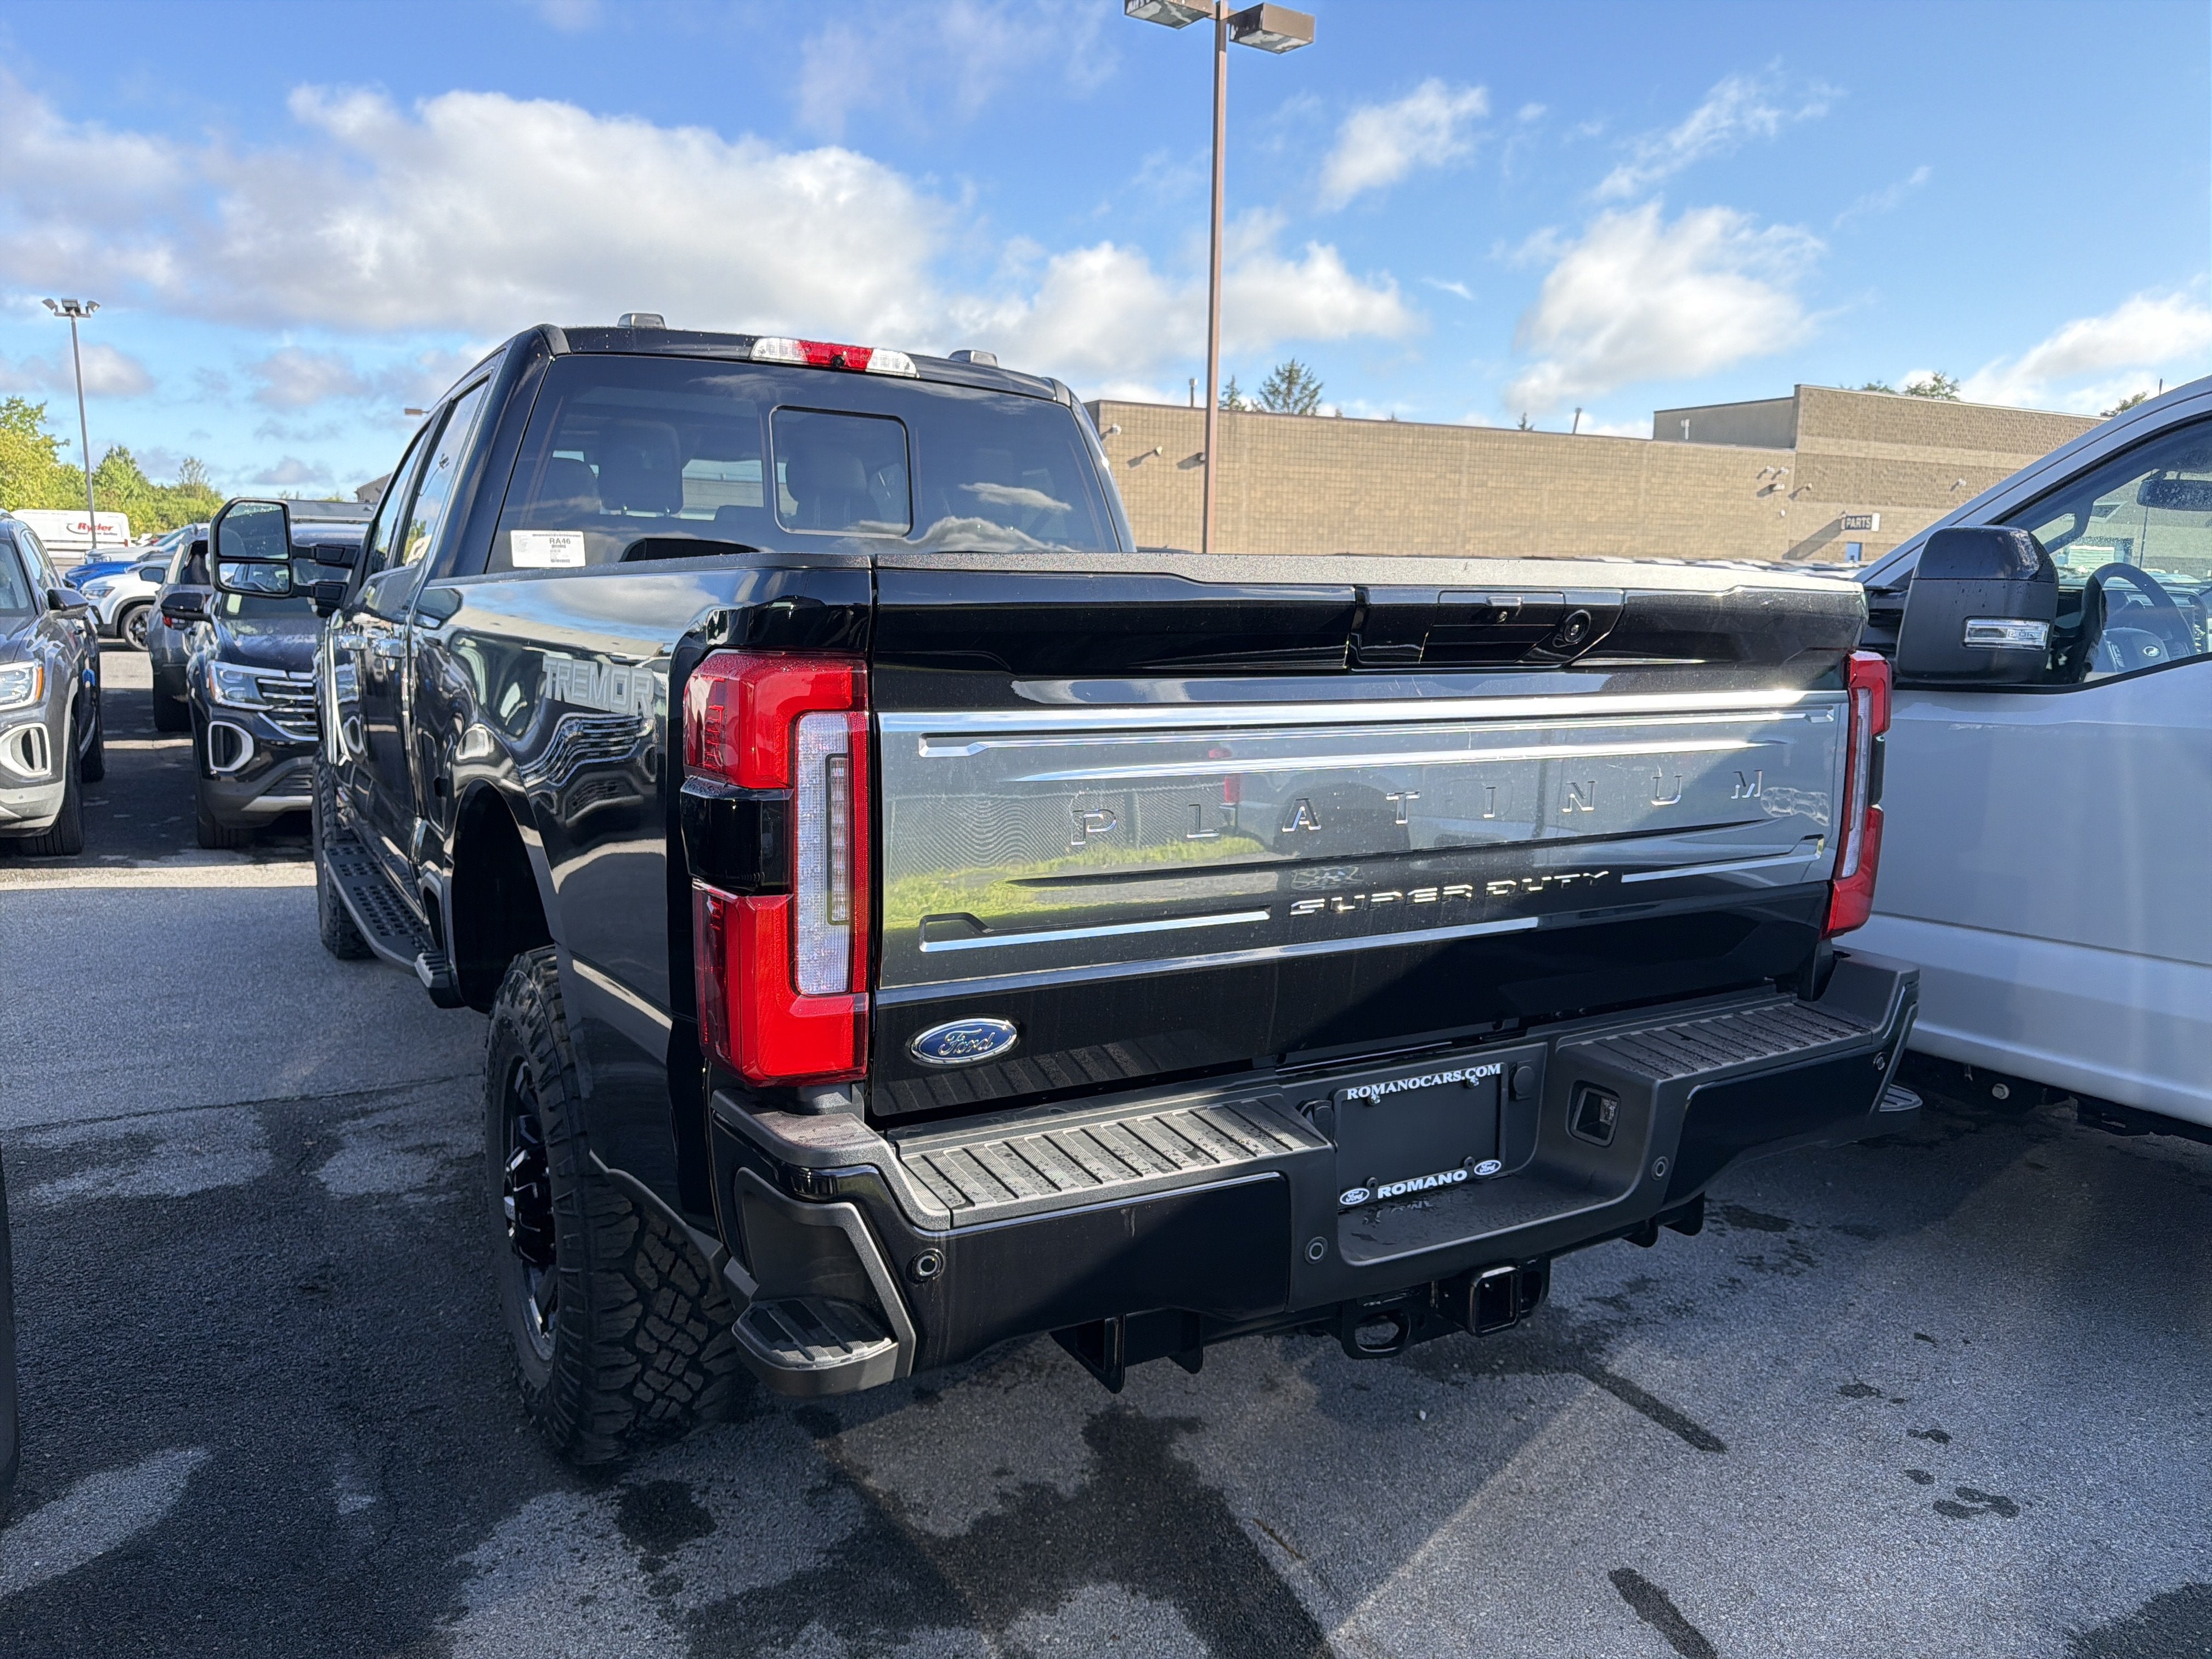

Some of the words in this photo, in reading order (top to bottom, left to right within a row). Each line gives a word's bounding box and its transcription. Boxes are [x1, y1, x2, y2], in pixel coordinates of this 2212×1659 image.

[1846, 517, 1871, 528] PARTS
[543, 656, 655, 719] TREMOR
[1071, 769, 1763, 846] PLATINUM
[1289, 884, 1473, 917] SUPER
[1485, 870, 1609, 897] DUTY
[938, 1028, 996, 1056] Ford
[1347, 1063, 1501, 1100] ROMANOCARS.COM
[1346, 1190, 1364, 1203] Ford
[1378, 1170, 1467, 1199] ROMANO
[1480, 1162, 1495, 1173] Ford
